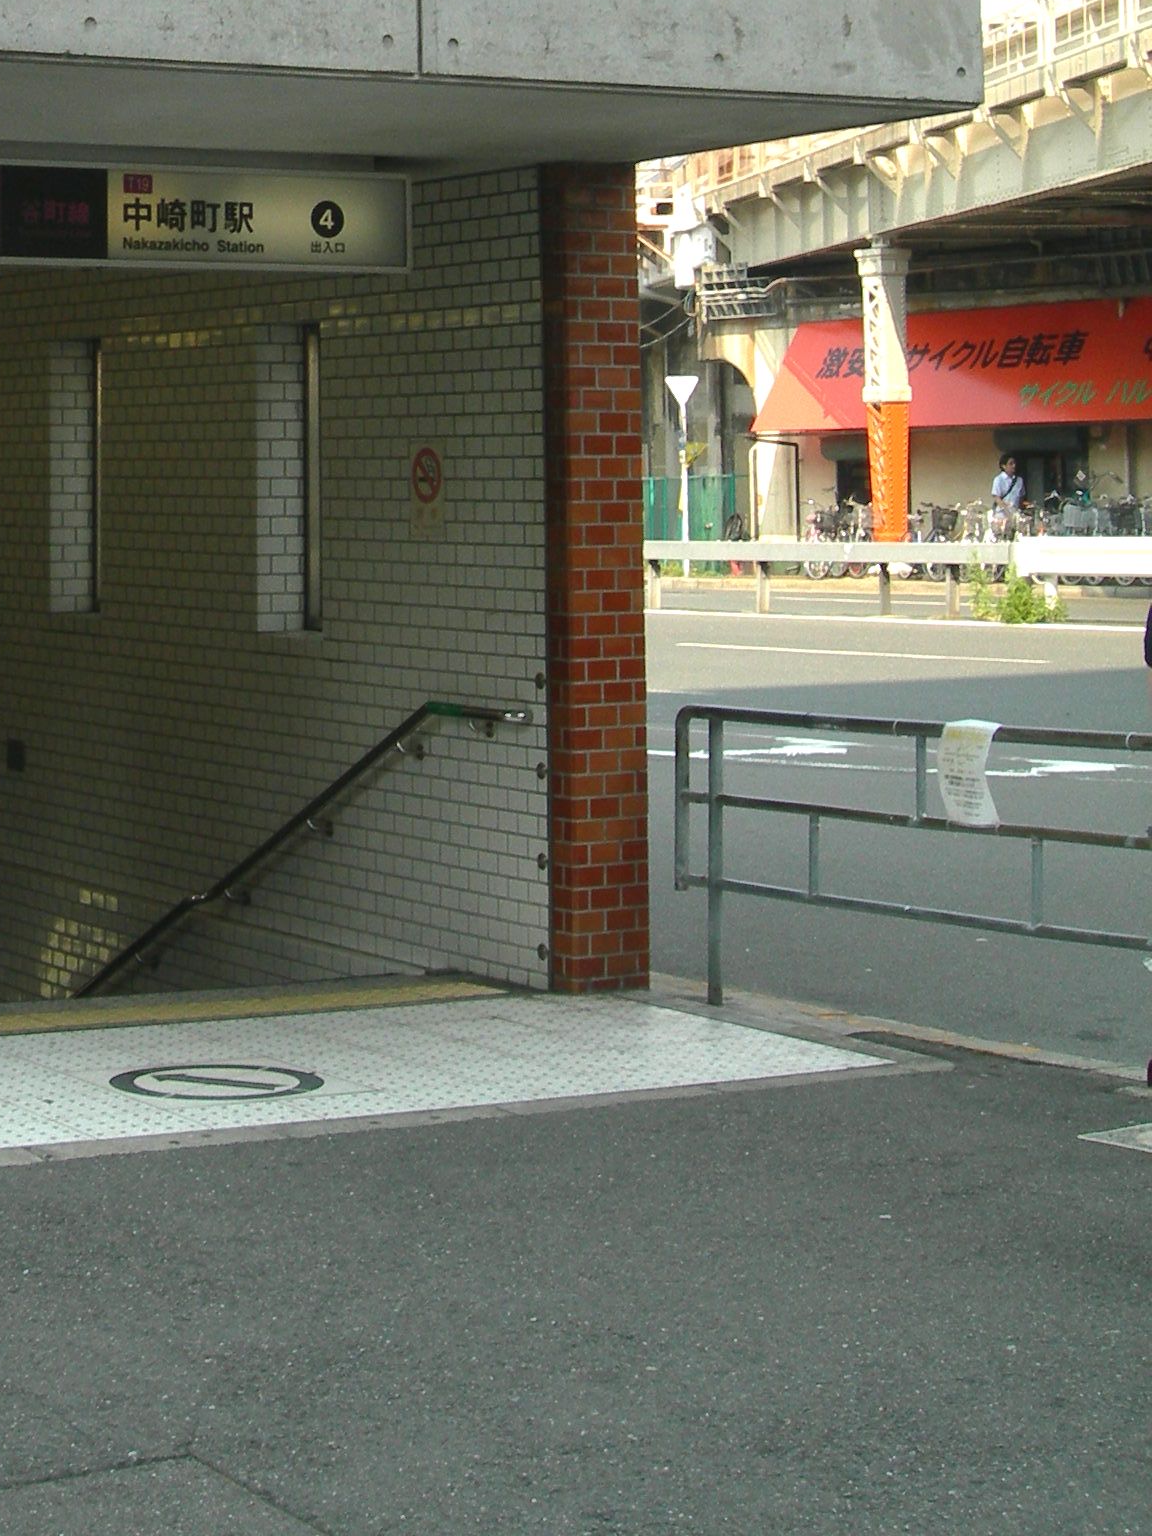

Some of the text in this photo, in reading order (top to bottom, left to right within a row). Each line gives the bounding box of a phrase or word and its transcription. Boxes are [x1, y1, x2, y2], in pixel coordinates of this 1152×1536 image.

[122, 197, 254, 234] 中崎町駅
[318, 208, 335, 230] 4
[122, 236, 265, 254] Nakazakicho Station
[310, 241, 346, 254] 出入口
[815, 329, 1090, 379] 激安サイクル自転車
